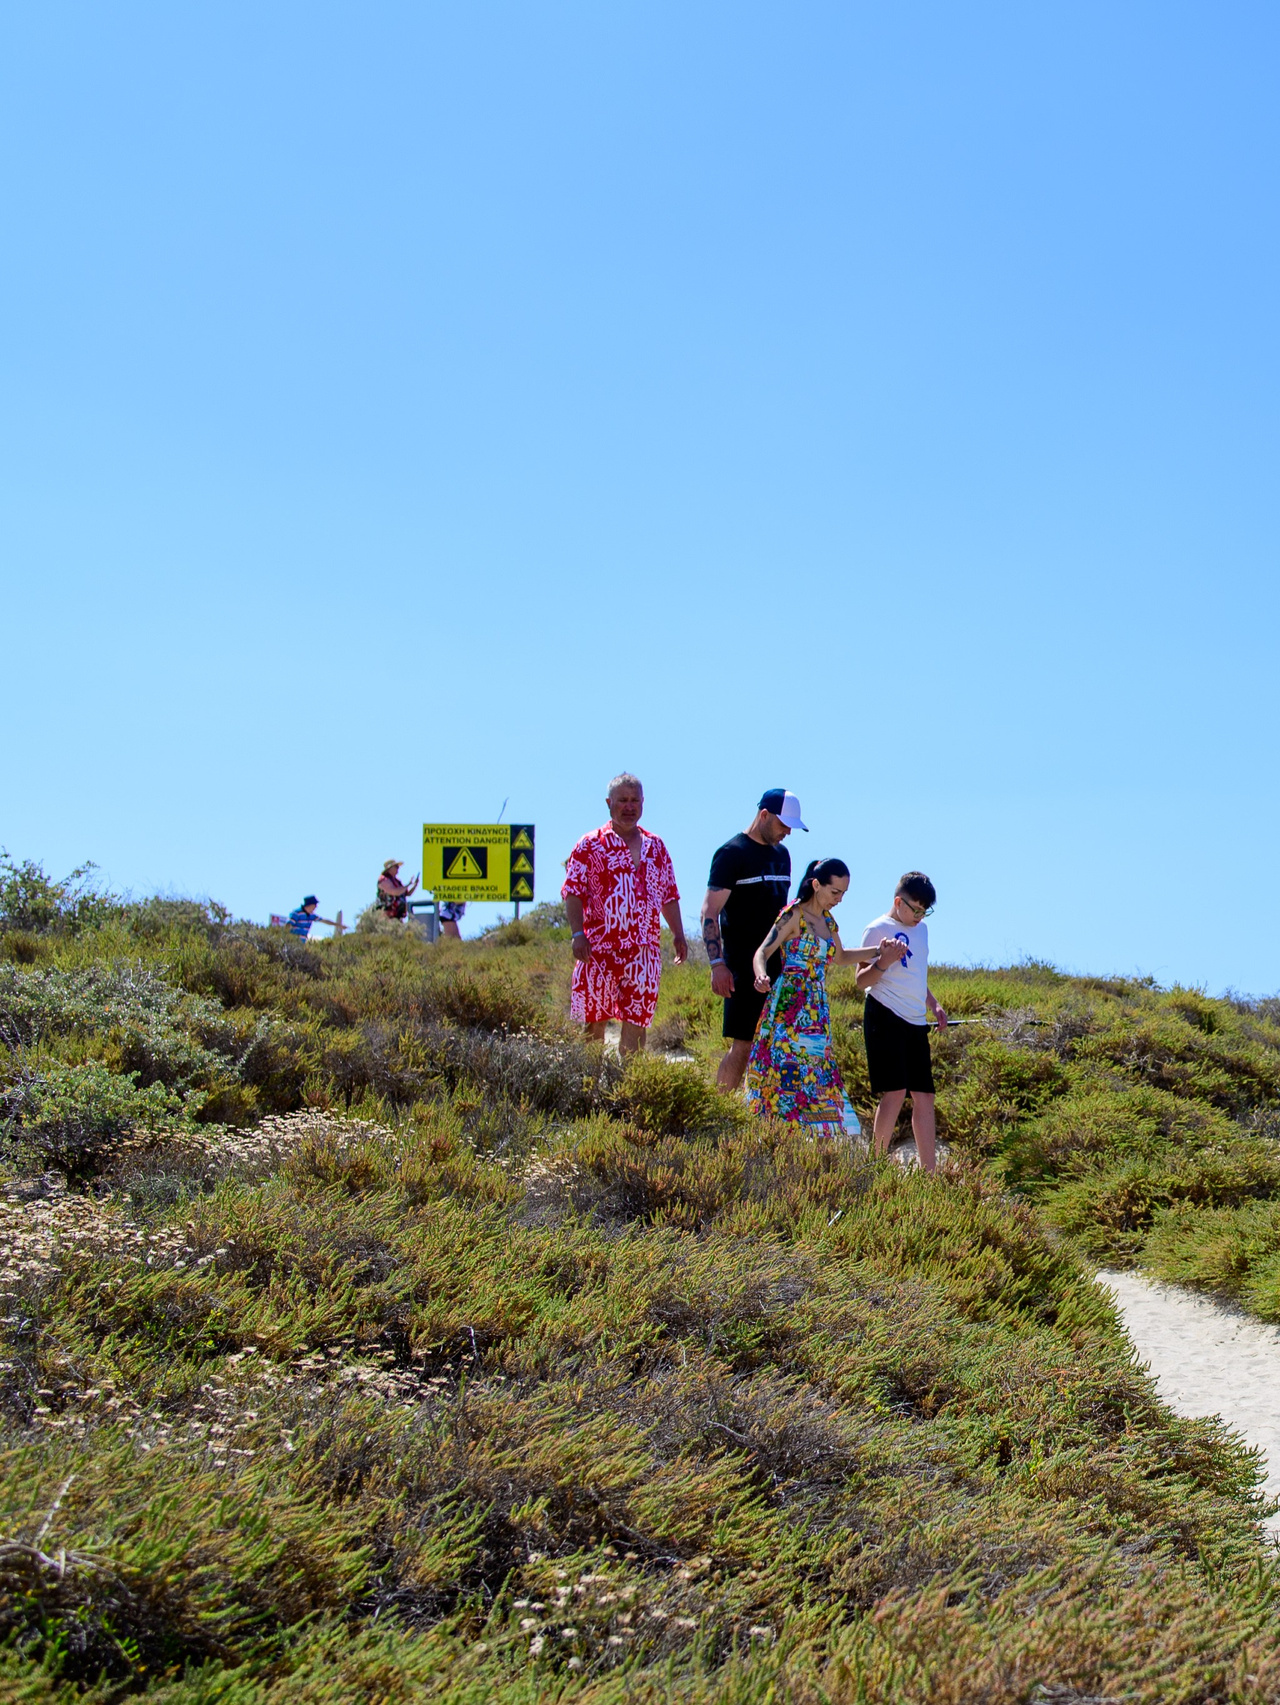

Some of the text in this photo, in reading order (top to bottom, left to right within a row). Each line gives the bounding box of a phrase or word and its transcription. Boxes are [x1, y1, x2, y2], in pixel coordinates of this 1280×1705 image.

[424, 827, 509, 835] ΠΡΟΣΟΧΗ ΚΙΝΔΥΝΟΣ
[424, 836, 509, 844] ATTENTION DANGER
